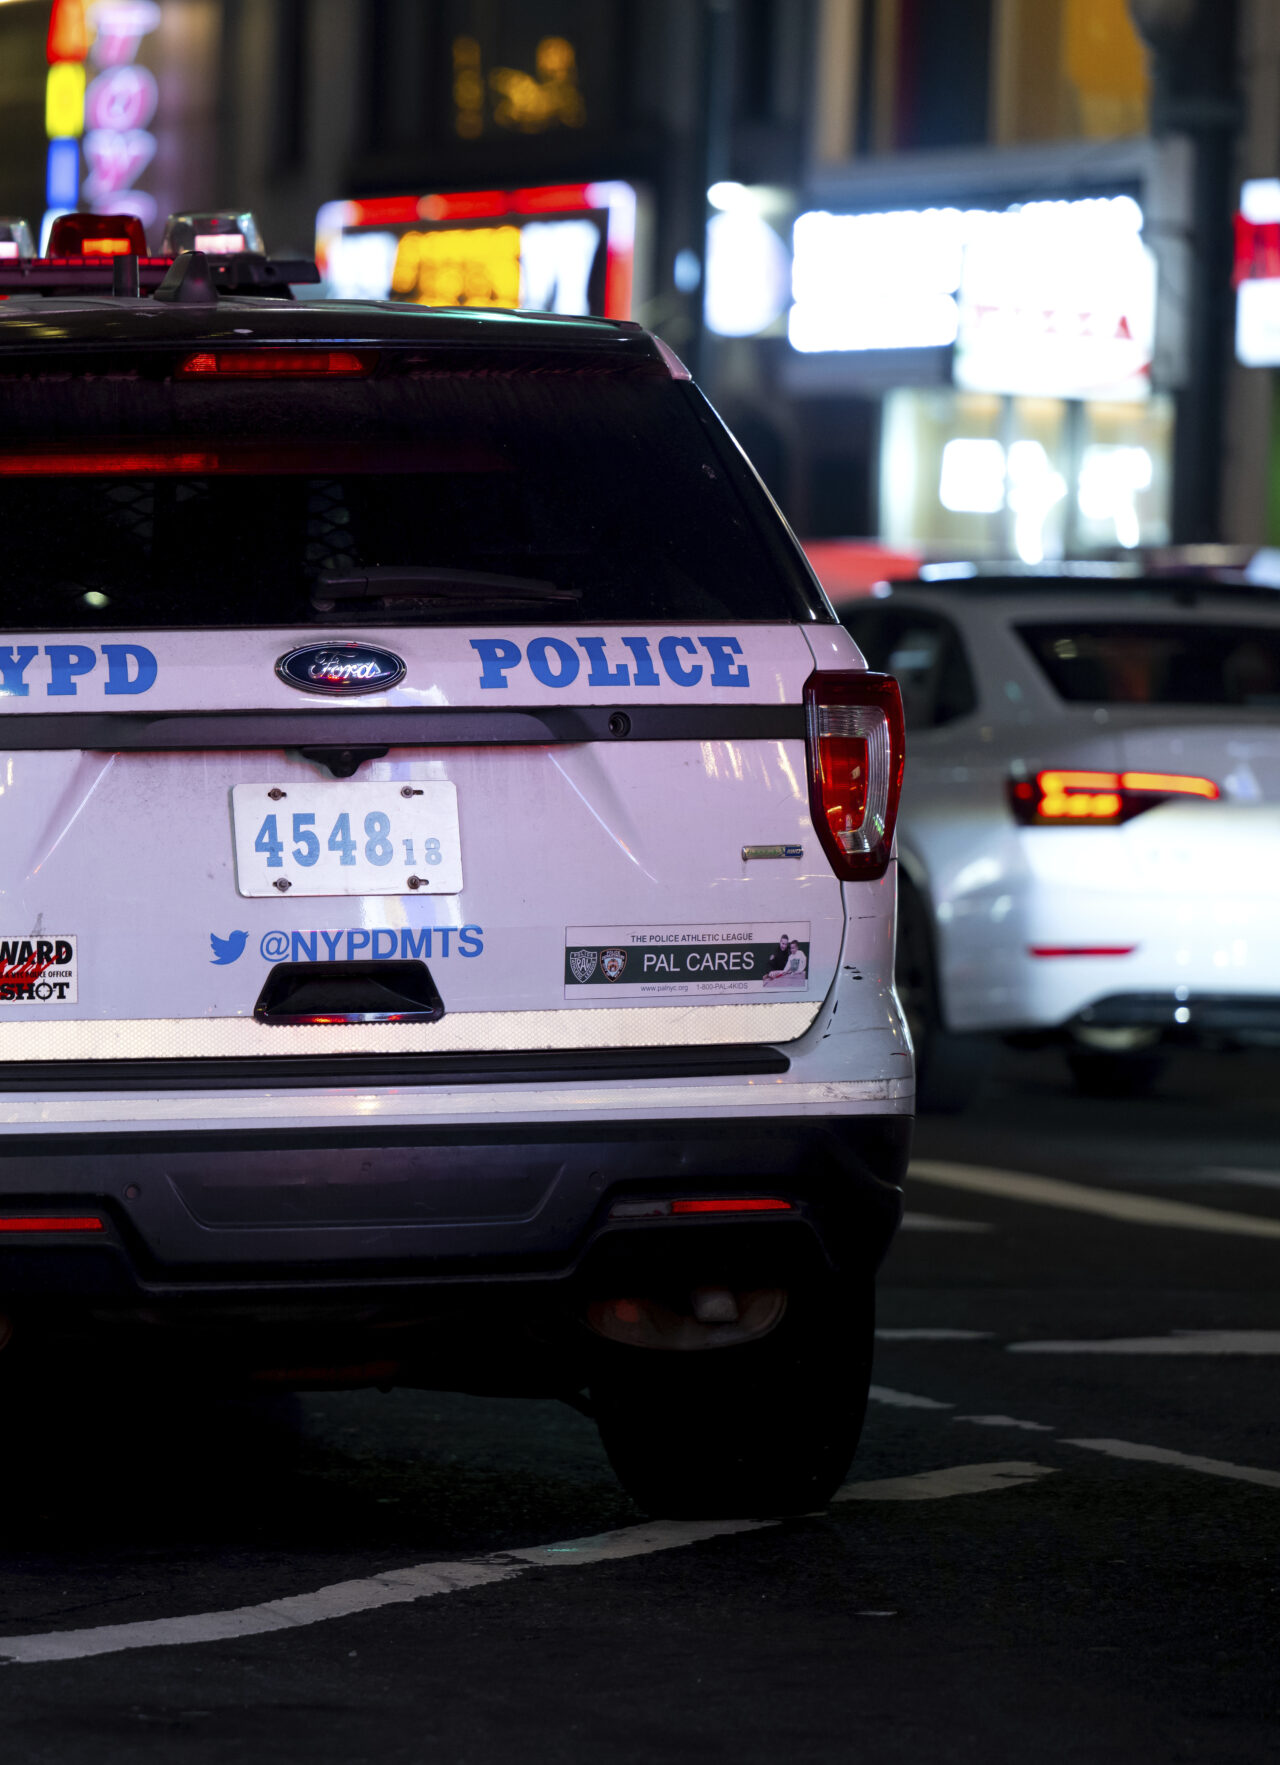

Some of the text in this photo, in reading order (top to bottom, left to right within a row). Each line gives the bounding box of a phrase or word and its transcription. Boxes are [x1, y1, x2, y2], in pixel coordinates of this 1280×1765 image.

[308, 651, 394, 680] Ford
[469, 636, 750, 689] POLICE
[254, 811, 442, 868] 4548 18
[259, 924, 485, 963] @NYPDMTS
[631, 932, 753, 943] THE POLICE ATHLETIC LEAGUE
[48, 970, 73, 978] OFFICER
[643, 953, 680, 972] PAL
[686, 951, 755, 971] CARES
